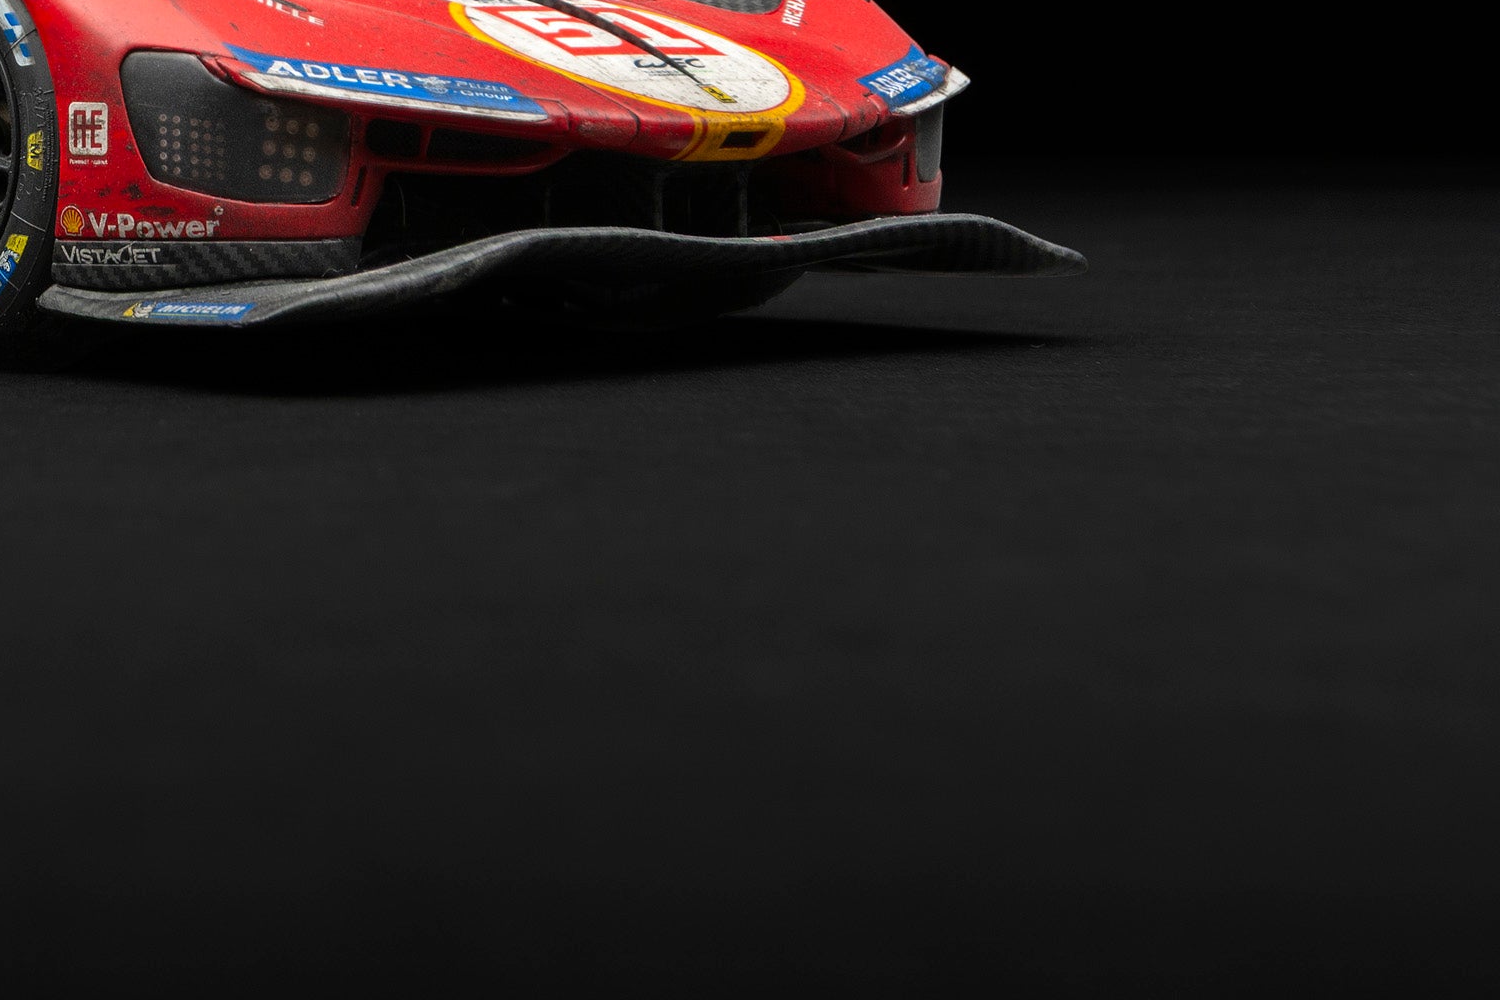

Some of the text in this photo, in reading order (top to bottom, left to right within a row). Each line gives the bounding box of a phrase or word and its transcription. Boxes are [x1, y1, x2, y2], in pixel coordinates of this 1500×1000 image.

[266, 60, 413, 89] ADLER
[88, 213, 219, 238] V-Power
[158, 304, 245, 315] MICHELIN
